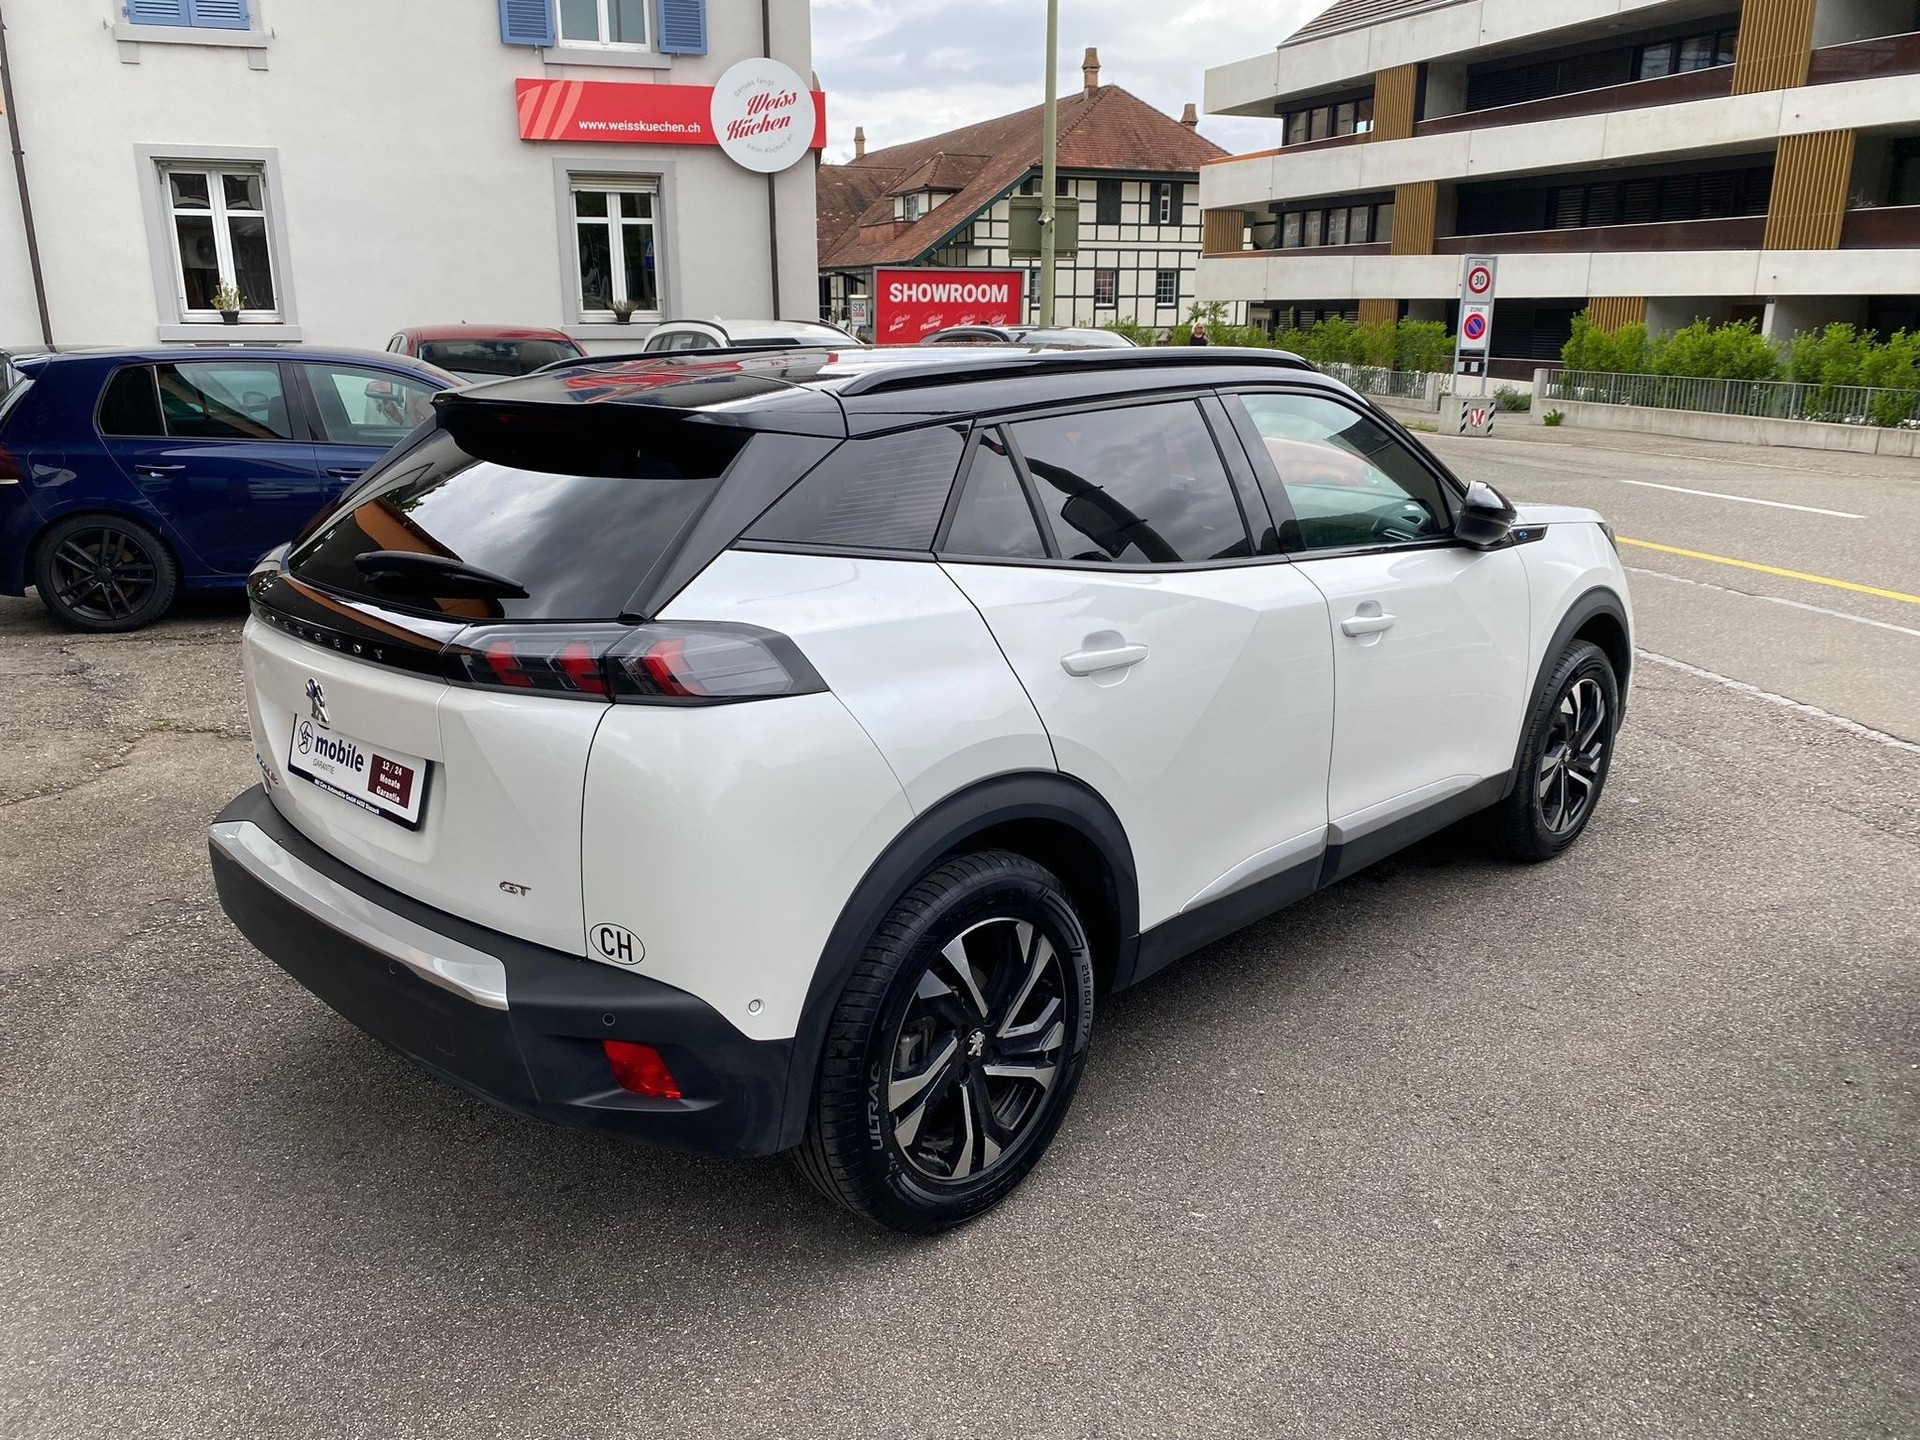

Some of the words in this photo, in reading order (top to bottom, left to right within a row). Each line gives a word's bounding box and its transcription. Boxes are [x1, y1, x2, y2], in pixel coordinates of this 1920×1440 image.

[747, 90, 797, 116] Weiss
[578, 120, 701, 133] www.weisskuechen.ch
[727, 114, 791, 141] Küchen
[1474, 275, 1485, 286] 30
[889, 283, 1009, 303] SHOWROOM
[853, 302, 865, 312] SK
[315, 735, 364, 772] mobile
[382, 760, 390, 770] 12
[394, 767, 403, 776] 24
[379, 773, 401, 789] Monate
[376, 786, 401, 804] Garantie
[499, 881, 532, 896] GT
[600, 927, 633, 962] CH
[1081, 963, 1092, 1006] 215/60
[868, 1060, 884, 1151] ULTRAC
